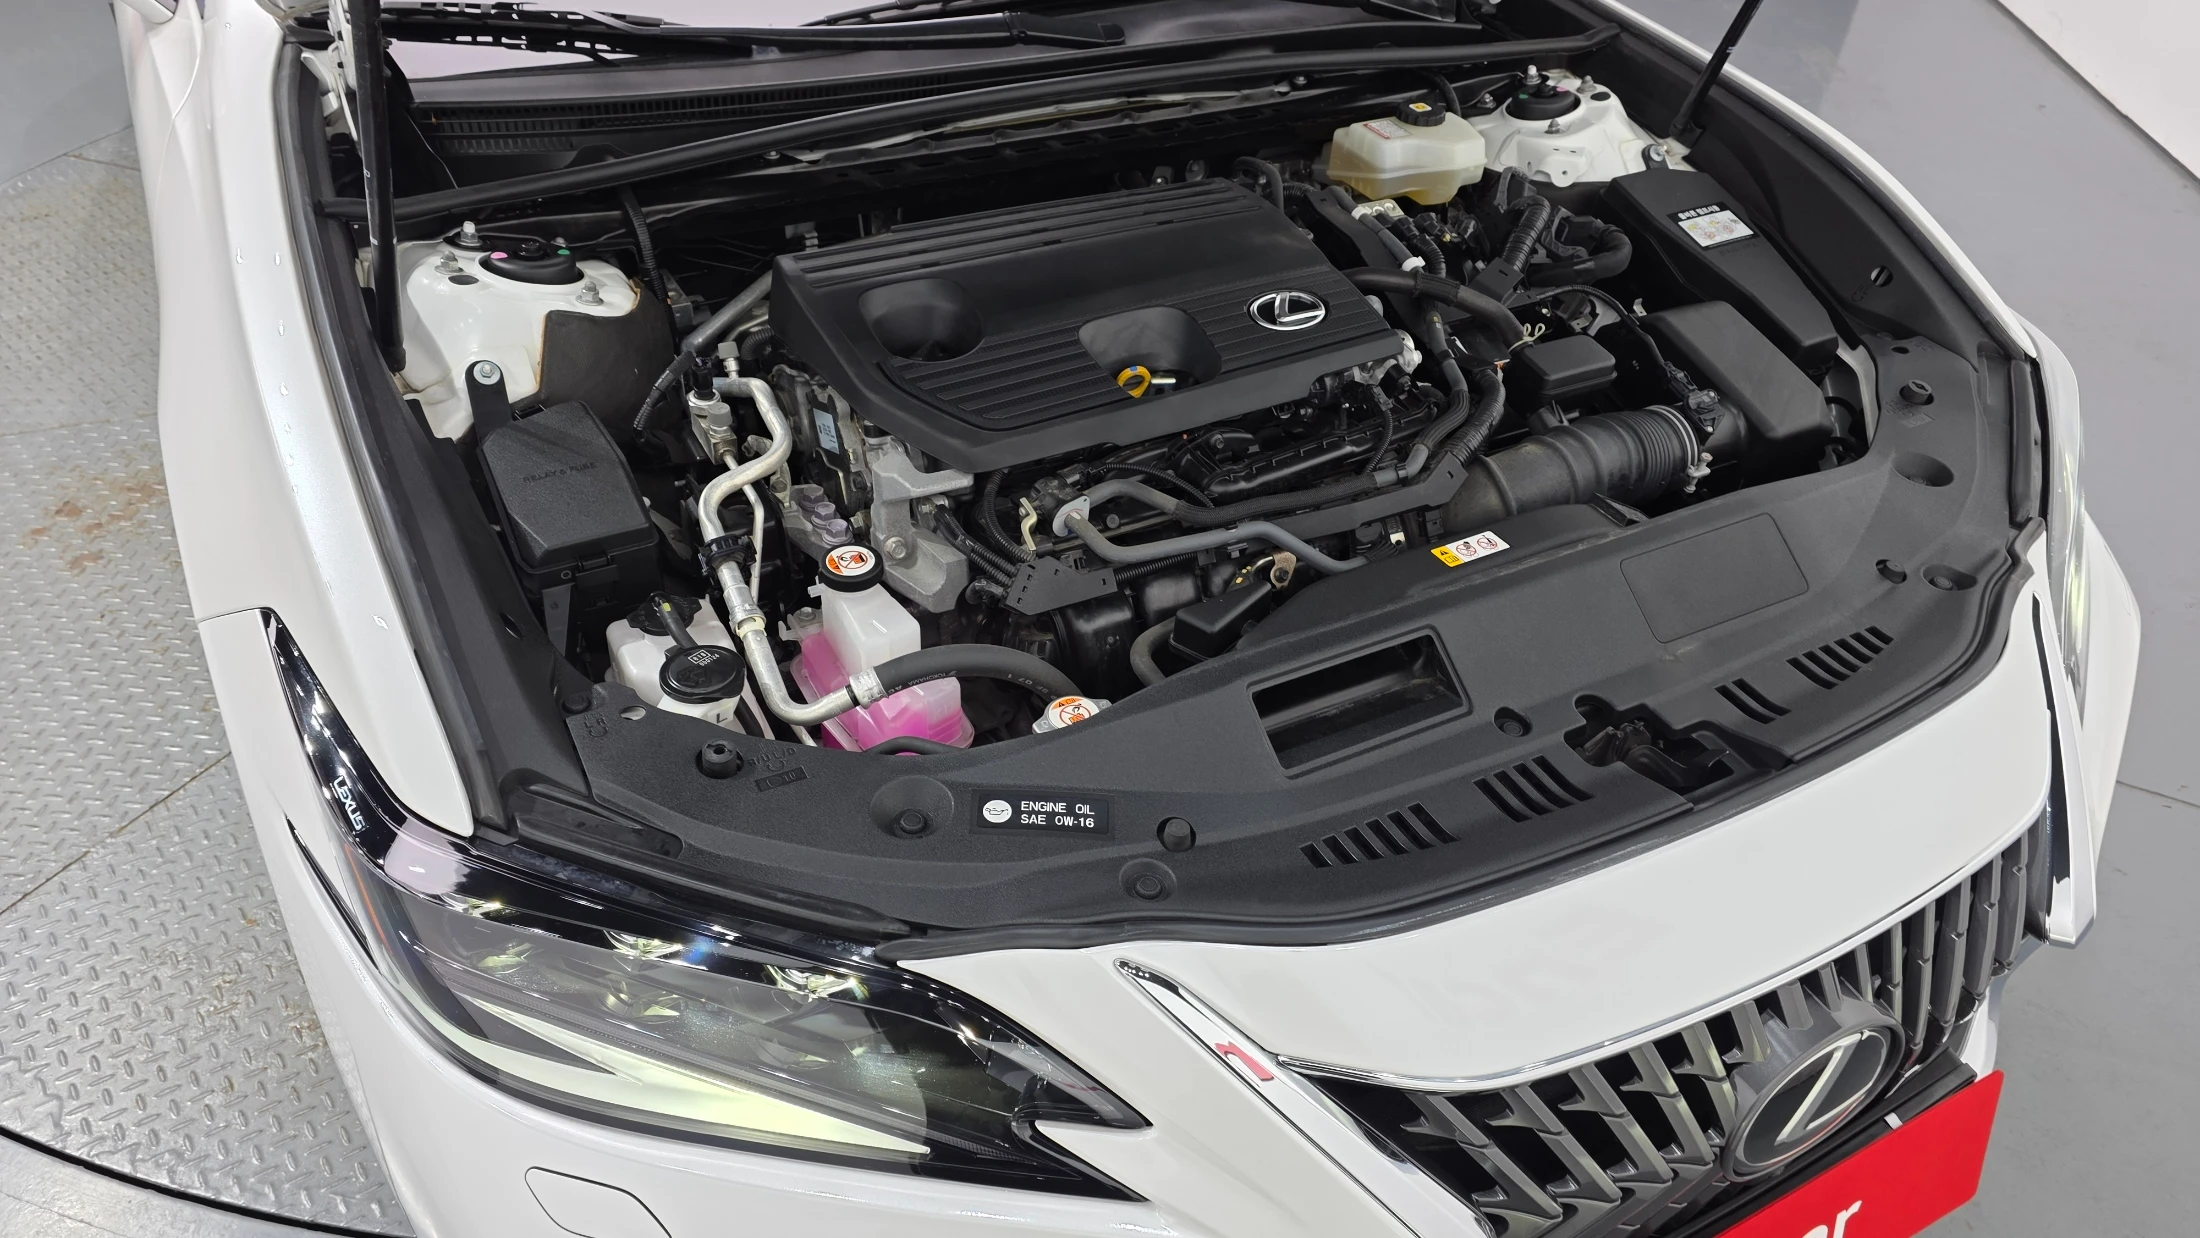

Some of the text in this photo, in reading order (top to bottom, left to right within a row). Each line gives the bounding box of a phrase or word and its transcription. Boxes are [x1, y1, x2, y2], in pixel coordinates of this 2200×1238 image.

[907, 672, 947, 687] YOKOHAMA
[333, 774, 367, 831] LEXUS
[1020, 800, 1095, 815] ENGINE OIL
[1020, 813, 1095, 828] SAE 0W-16
